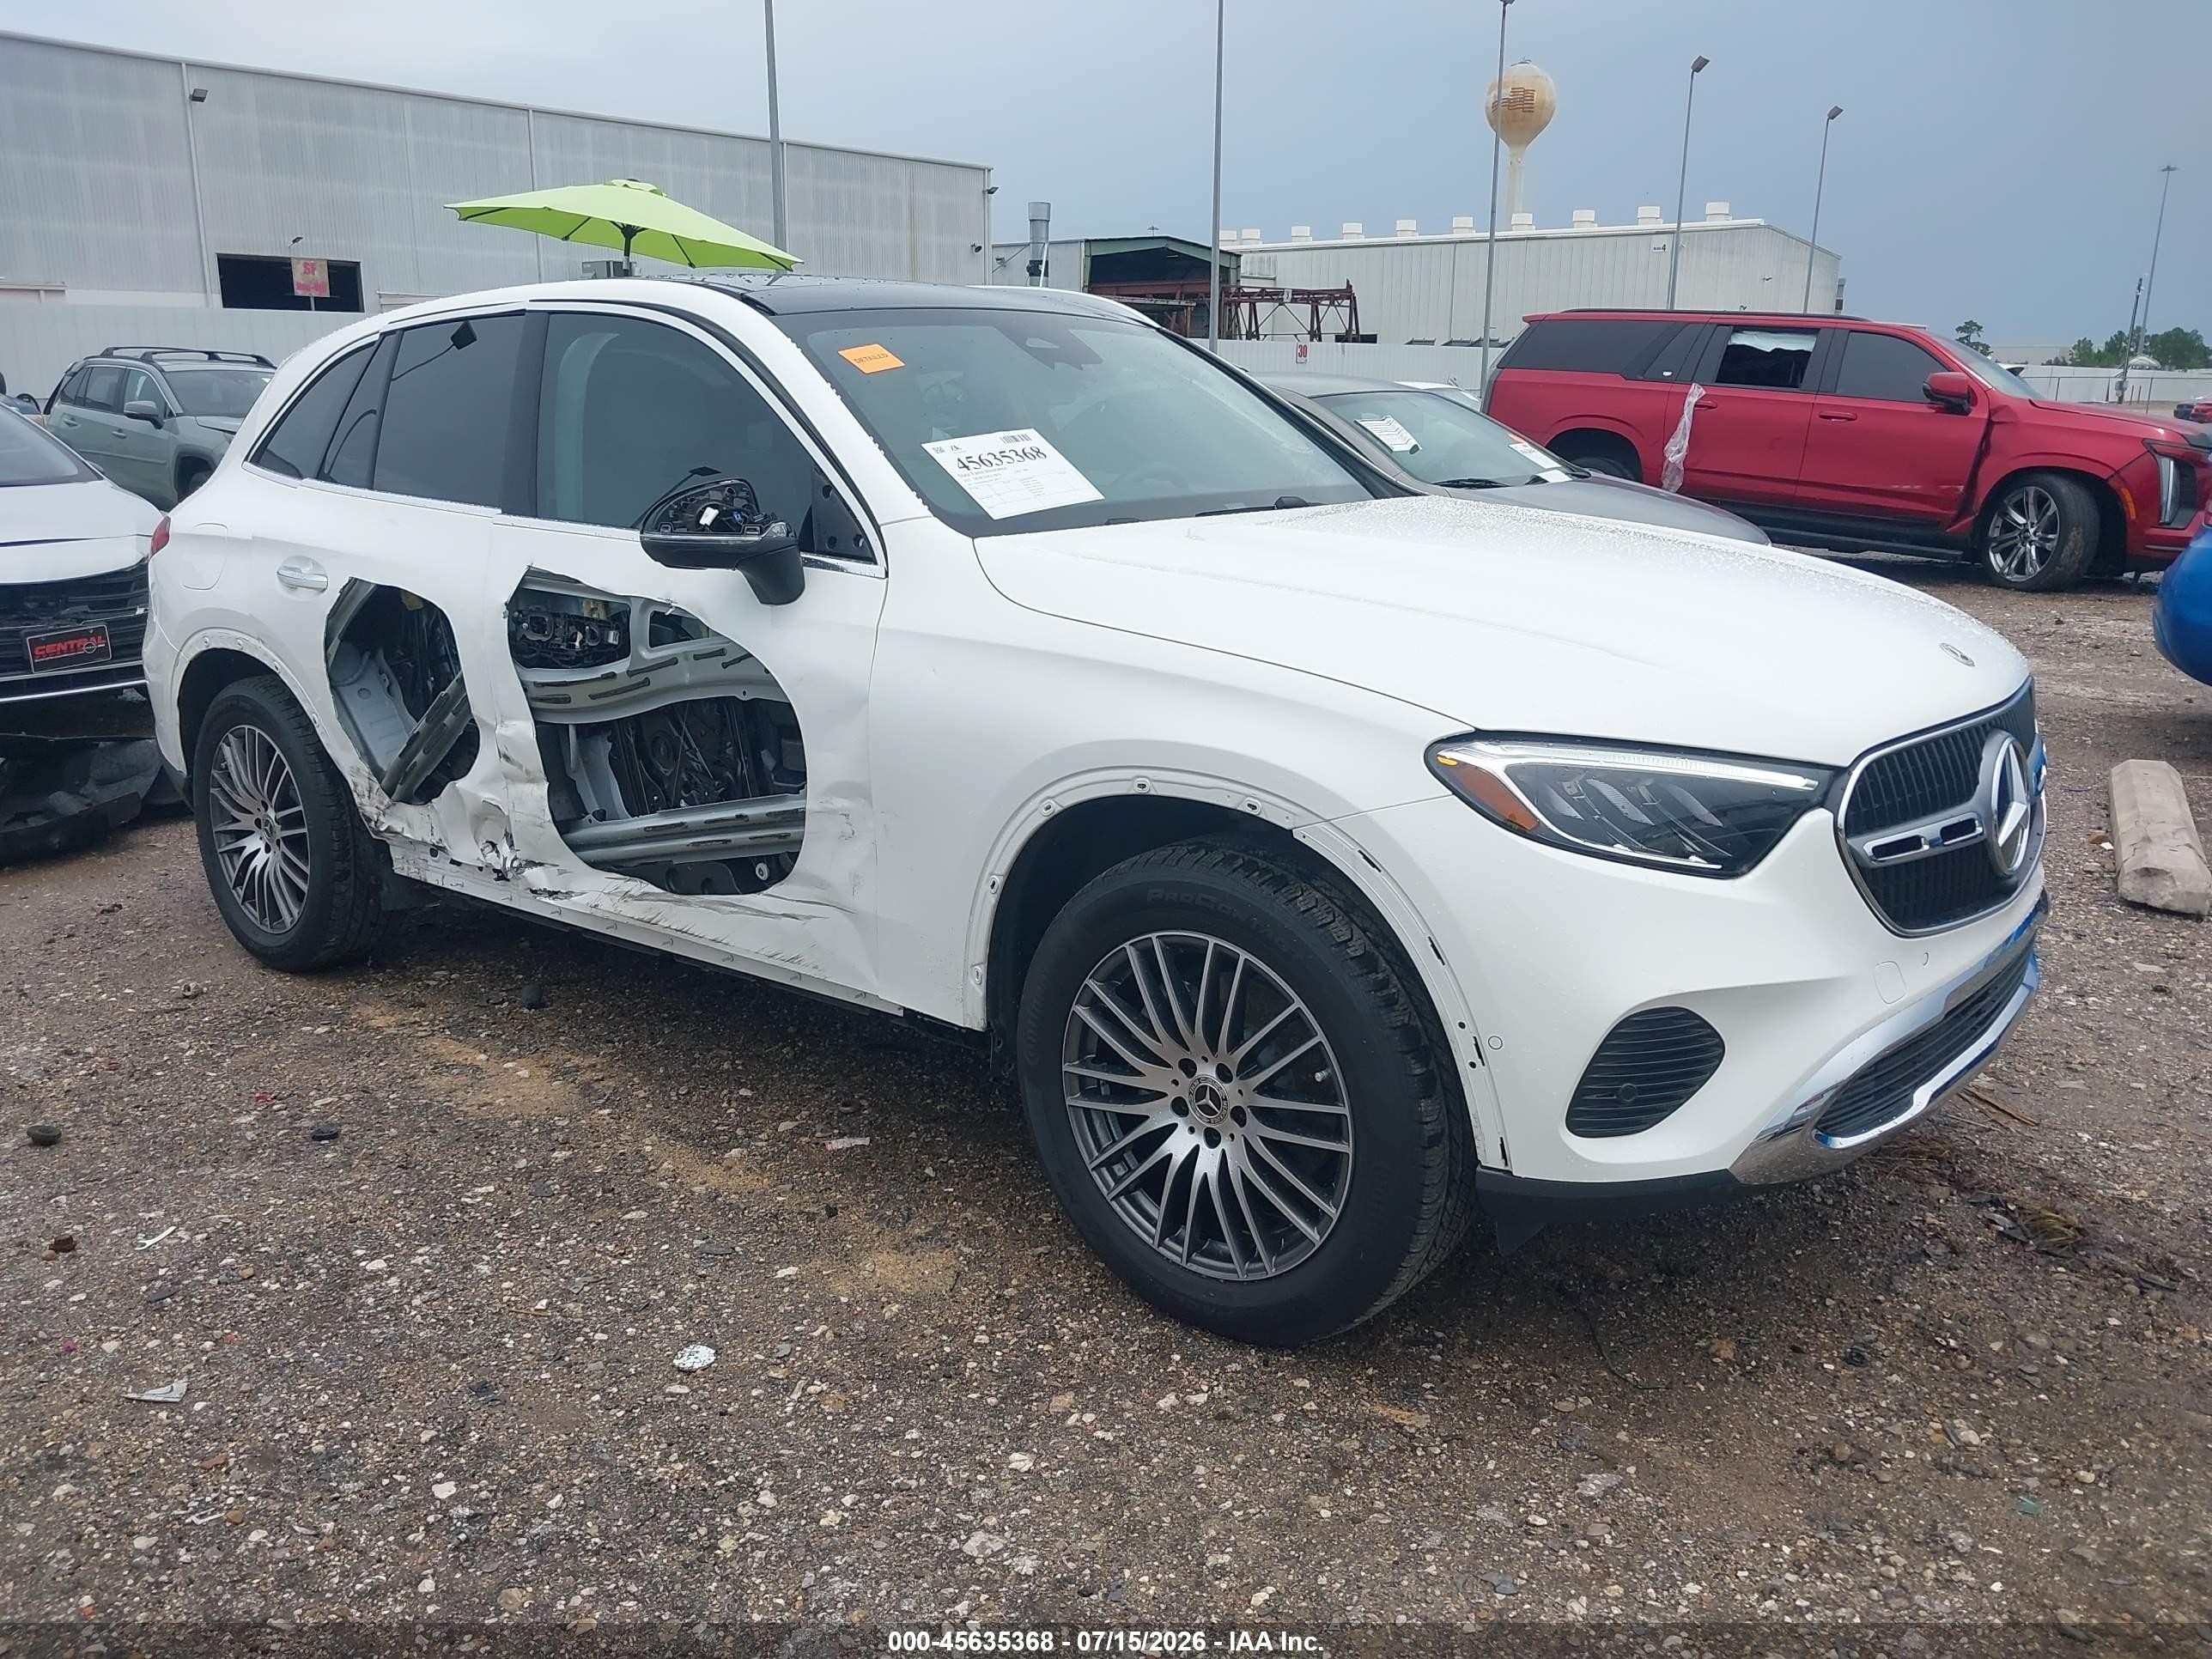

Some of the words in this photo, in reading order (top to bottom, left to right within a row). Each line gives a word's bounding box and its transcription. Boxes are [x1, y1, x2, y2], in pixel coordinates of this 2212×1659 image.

[1298, 344, 1307, 357] 30
[956, 446, 1047, 471] 45635368
[34, 635, 106, 656] CENTRAL
